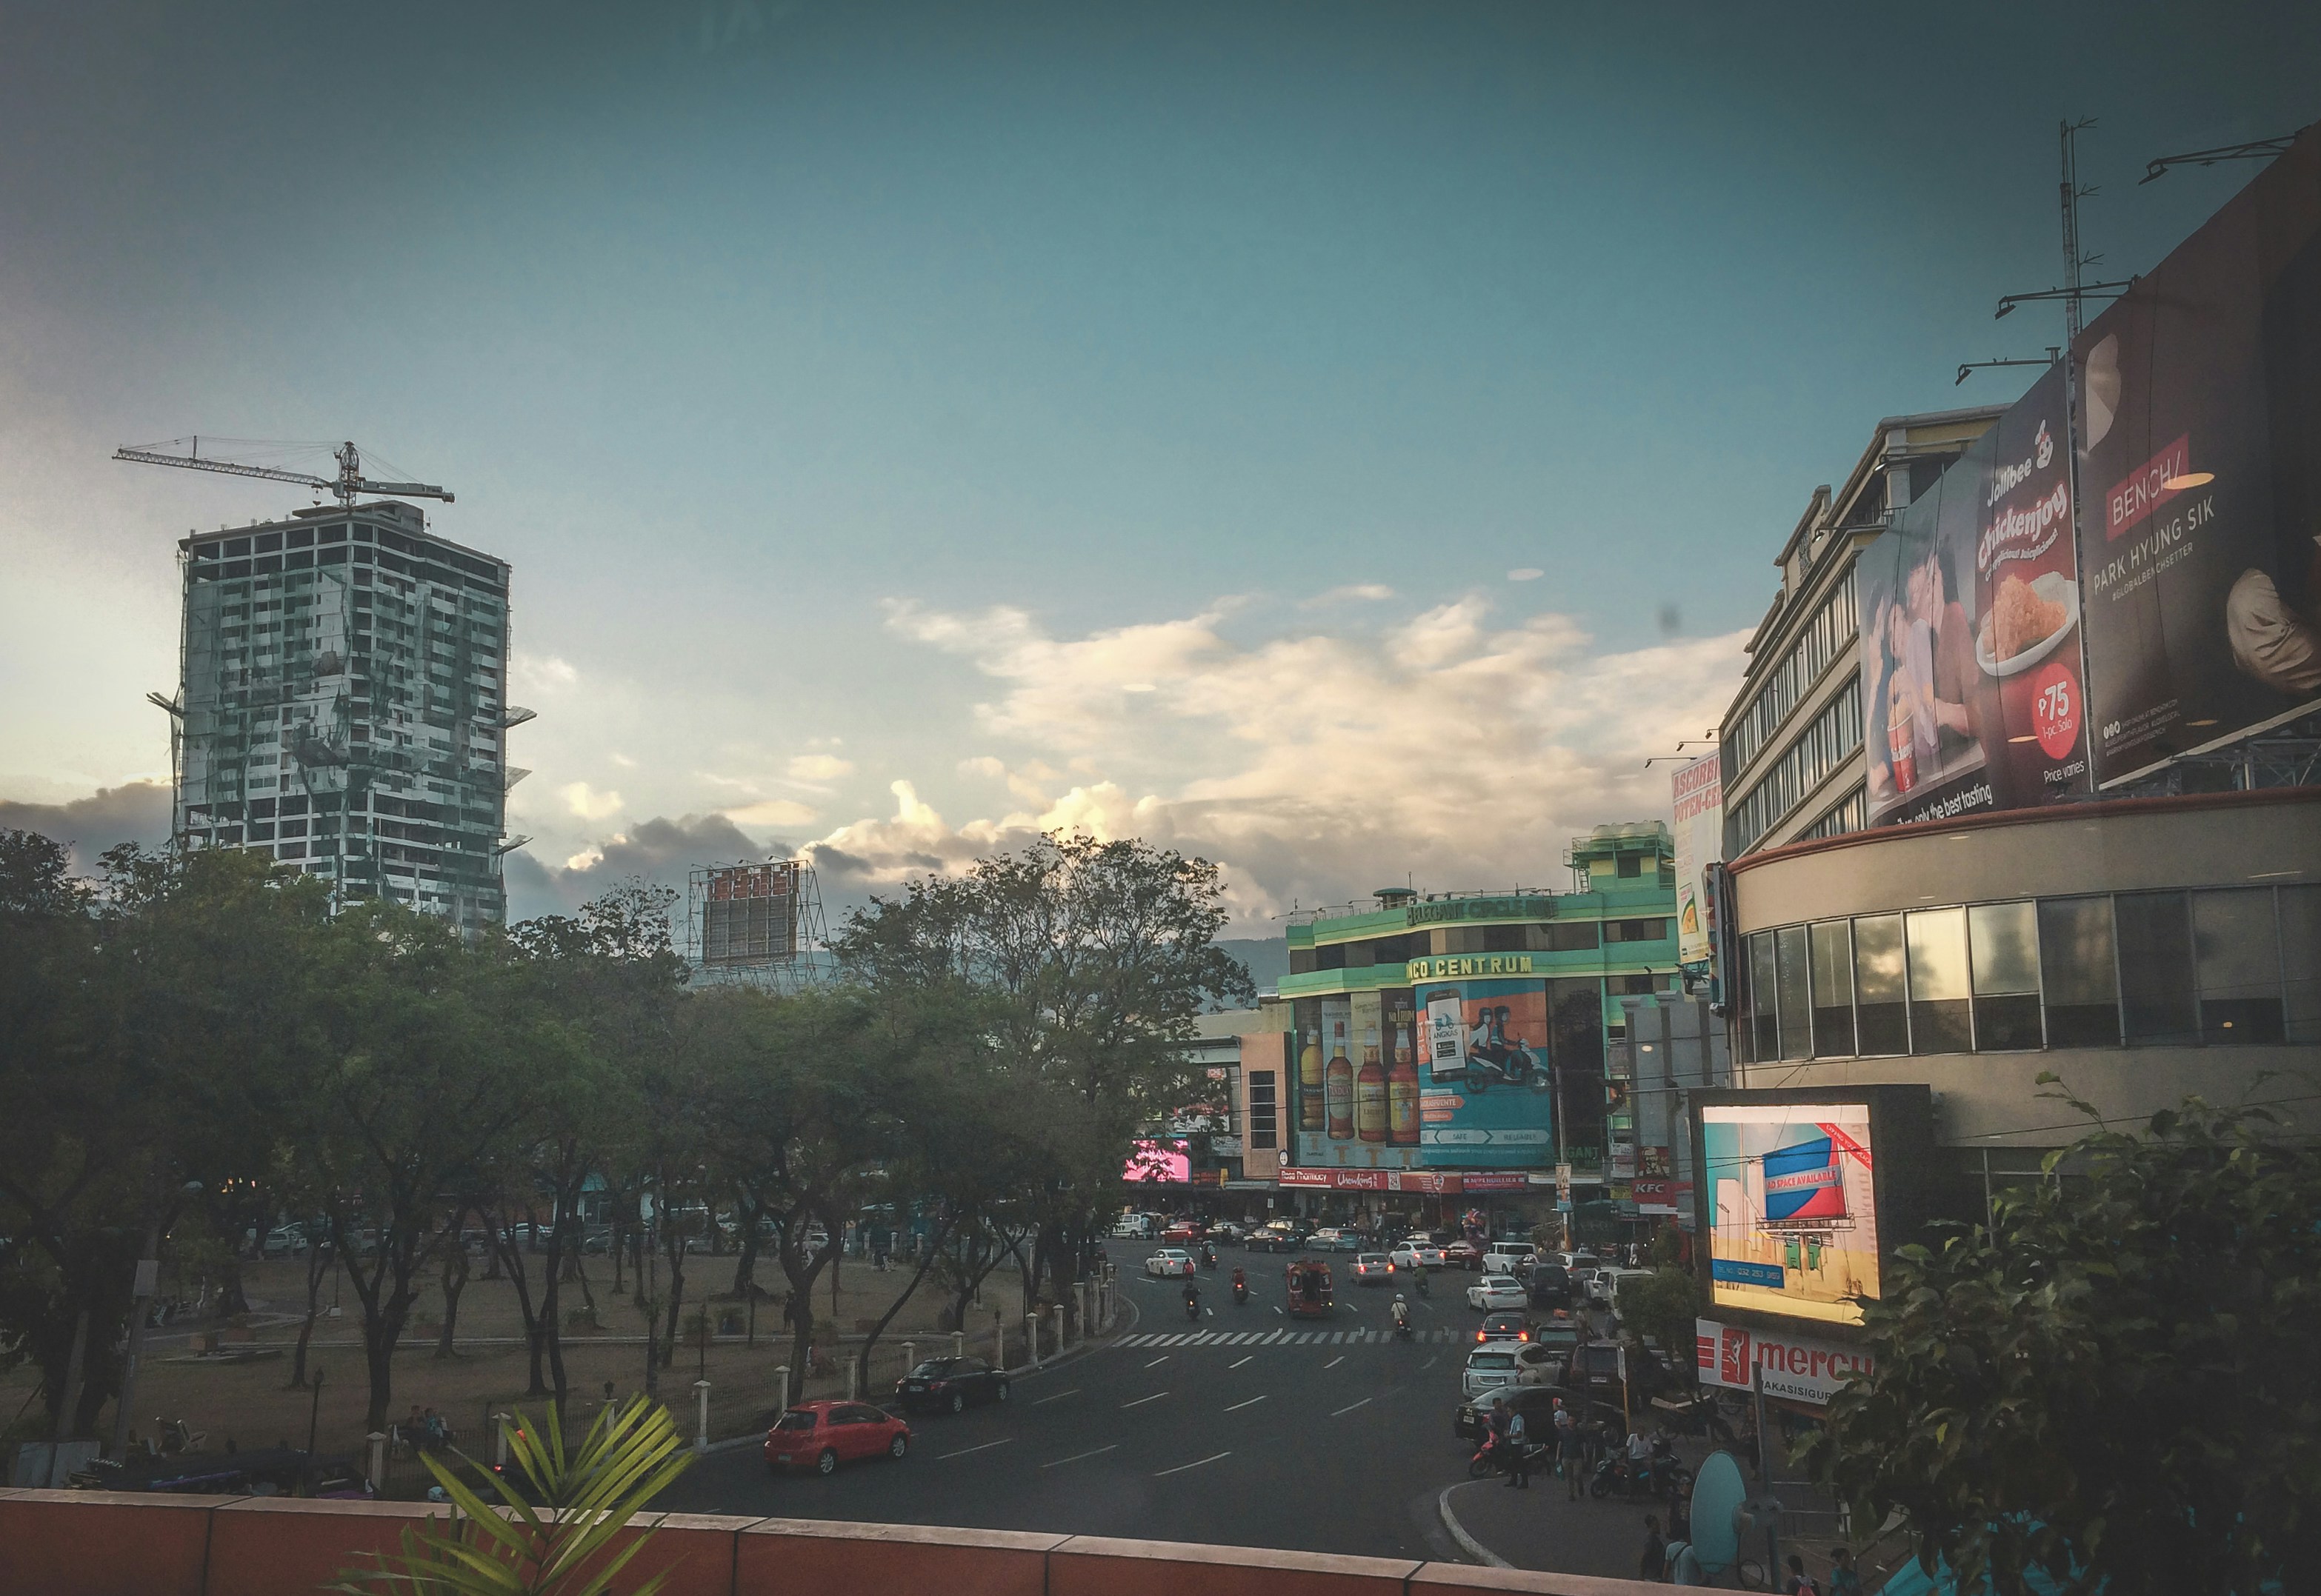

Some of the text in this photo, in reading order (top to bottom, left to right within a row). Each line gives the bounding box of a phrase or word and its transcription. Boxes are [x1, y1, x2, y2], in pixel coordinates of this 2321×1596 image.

[1987, 458, 2033, 507] Jollibee
[1978, 484, 2068, 569] Chickenjoy
[2094, 495, 2215, 595] PARK HYUNG SIK
[2112, 541, 2194, 601] #GLOBALBENCHSETTER
[2058, 716, 2073, 732] Solo
[1674, 755, 1721, 800] ASCORBI
[2044, 759, 2085, 784] Price varies
[1929, 802, 1945, 820] the
[1943, 792, 1963, 816] best
[1962, 782, 1994, 809] tasting
[1413, 902, 1465, 924] ELEGANT
[1468, 899, 1523, 918] CIRCLE
[1436, 957, 1532, 976] CENTRUM
[1402, 1010, 1415, 1022] RUM
[1433, 1029, 1459, 1040] ANGKAS
[1296, 1170, 1328, 1183] Pharmacy
[1337, 1172, 1373, 1188] Chowking
[1767, 1170, 1837, 1189] AD SPACE AVAILABLE
[1634, 1183, 1665, 1193] KFC
